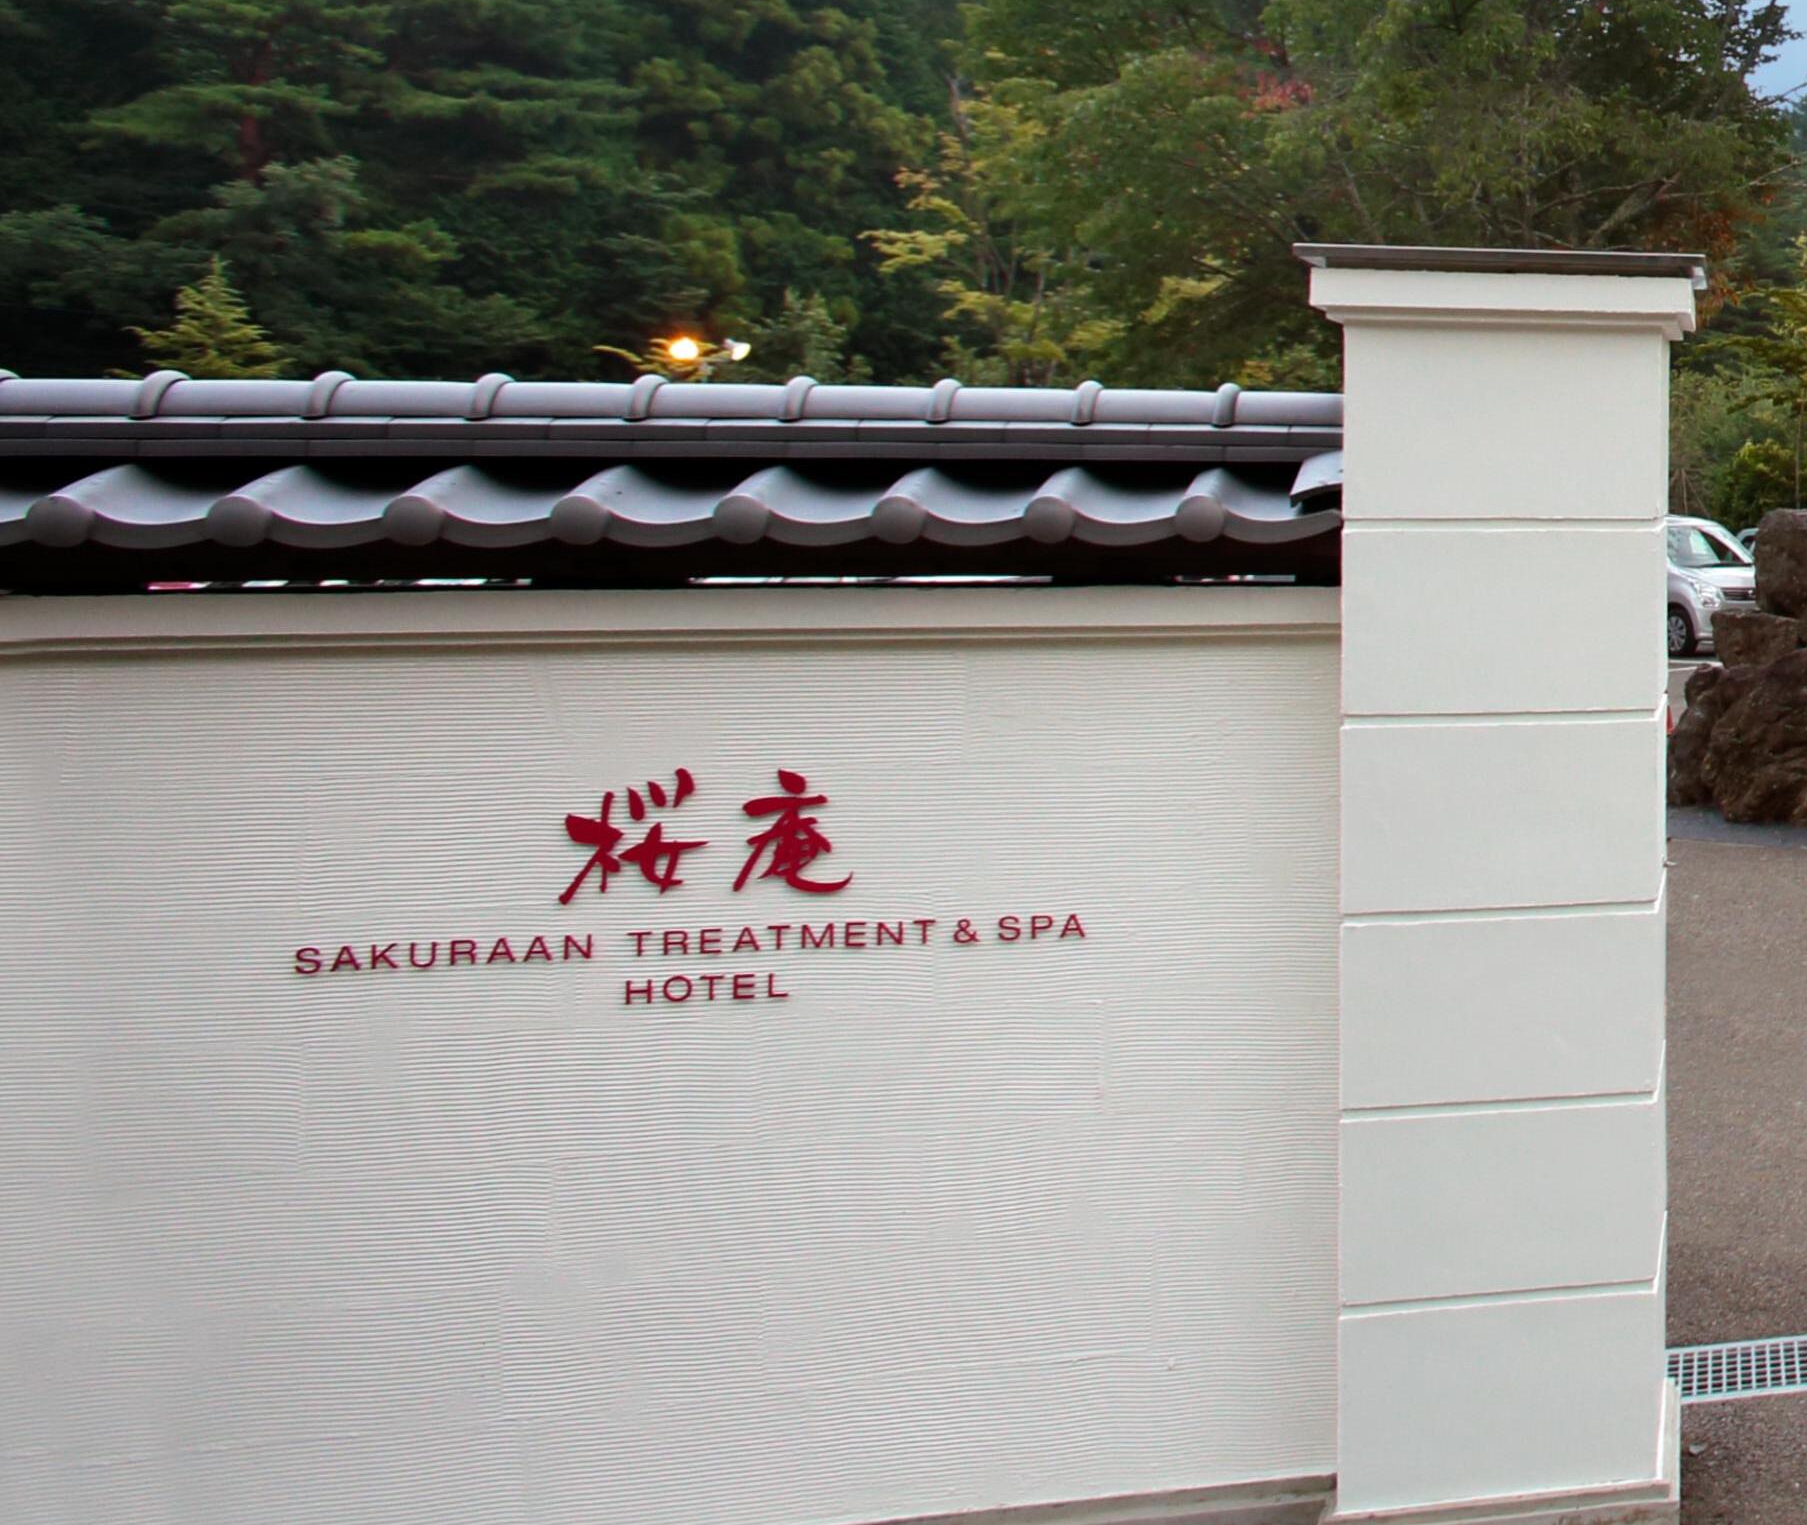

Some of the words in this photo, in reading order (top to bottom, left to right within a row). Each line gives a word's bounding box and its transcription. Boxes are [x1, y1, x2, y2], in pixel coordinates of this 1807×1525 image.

[294, 933, 596, 977] SAKURAAN
[627, 917, 938, 959] TREATMENT
[997, 912, 1088, 943] SPA
[623, 970, 791, 1006] HOTEL
